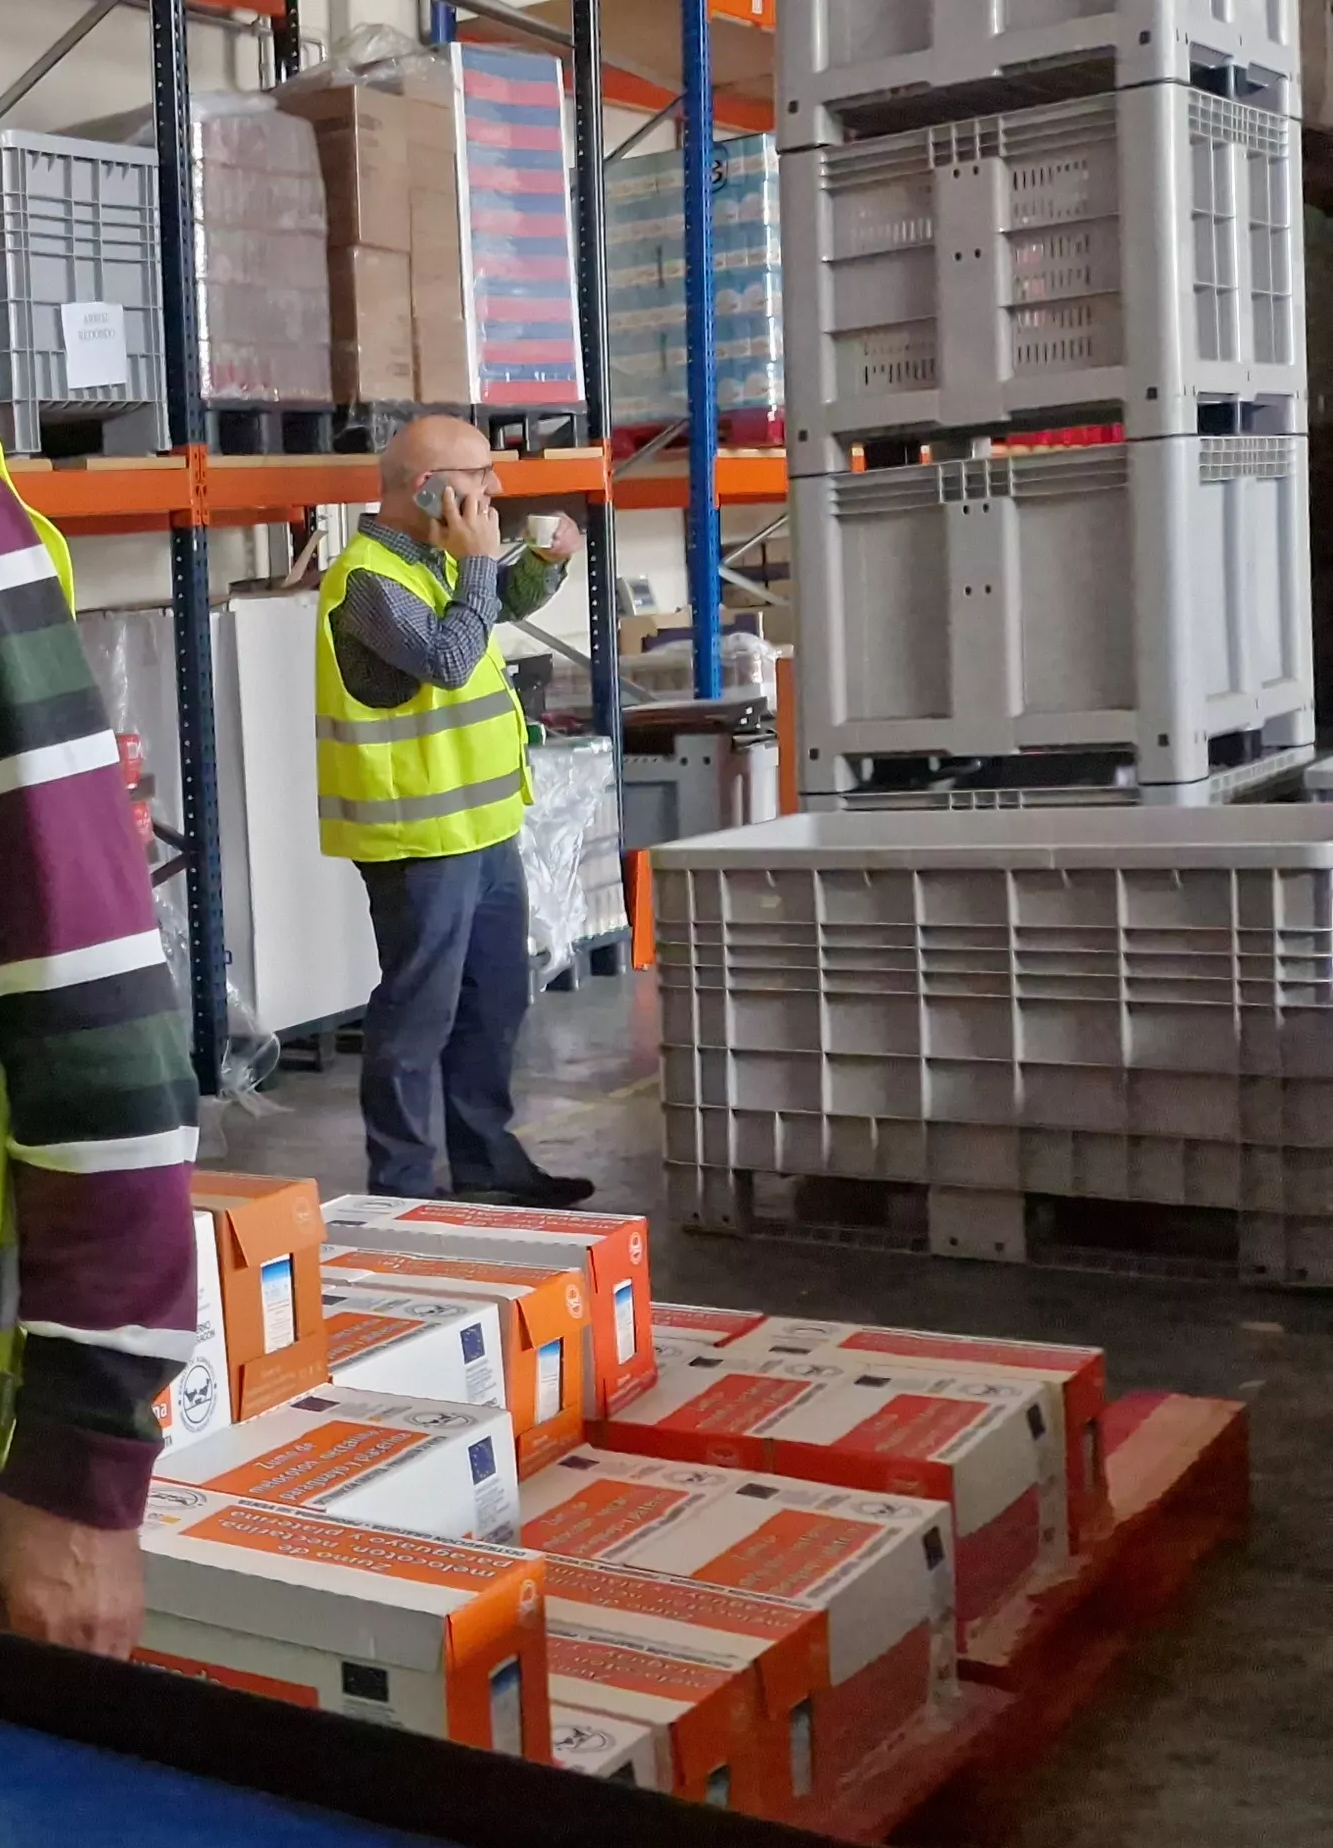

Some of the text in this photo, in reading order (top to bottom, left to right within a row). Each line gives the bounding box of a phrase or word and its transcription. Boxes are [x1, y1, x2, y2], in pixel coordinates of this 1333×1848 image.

[254, 1449, 294, 1471] Zumo
[217, 1518, 340, 1548] nectarina,
[230, 1511, 514, 1569] paraguayo y platerina
[277, 1543, 393, 1572] Zumo de
